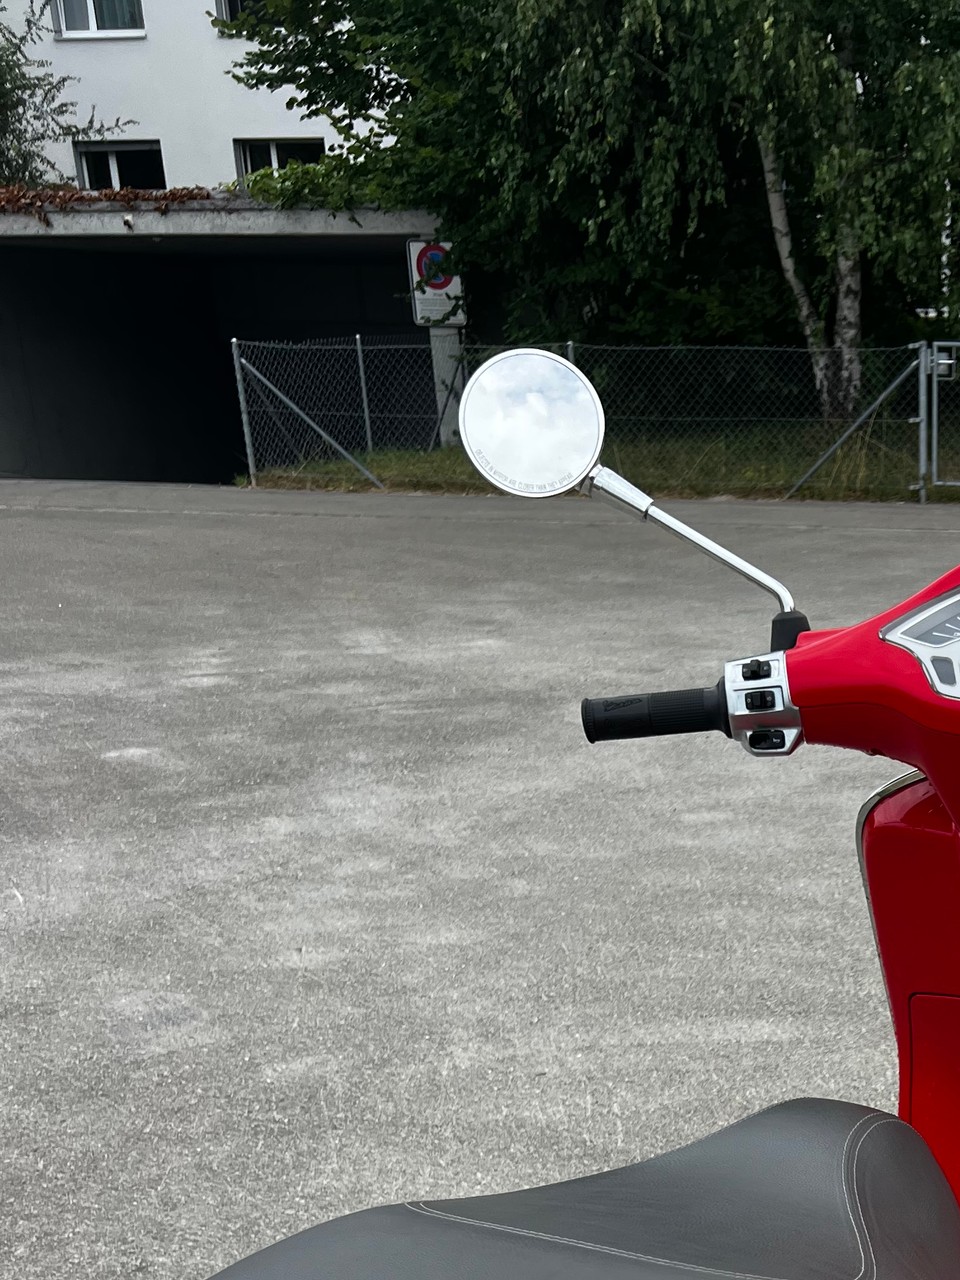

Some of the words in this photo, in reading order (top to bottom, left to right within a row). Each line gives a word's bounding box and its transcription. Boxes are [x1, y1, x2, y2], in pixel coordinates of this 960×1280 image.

[508, 478, 518, 487] ARE
[535, 483, 547, 491] THAN
[547, 481, 558, 489] THEY
[558, 472, 574, 486] APPEAR
